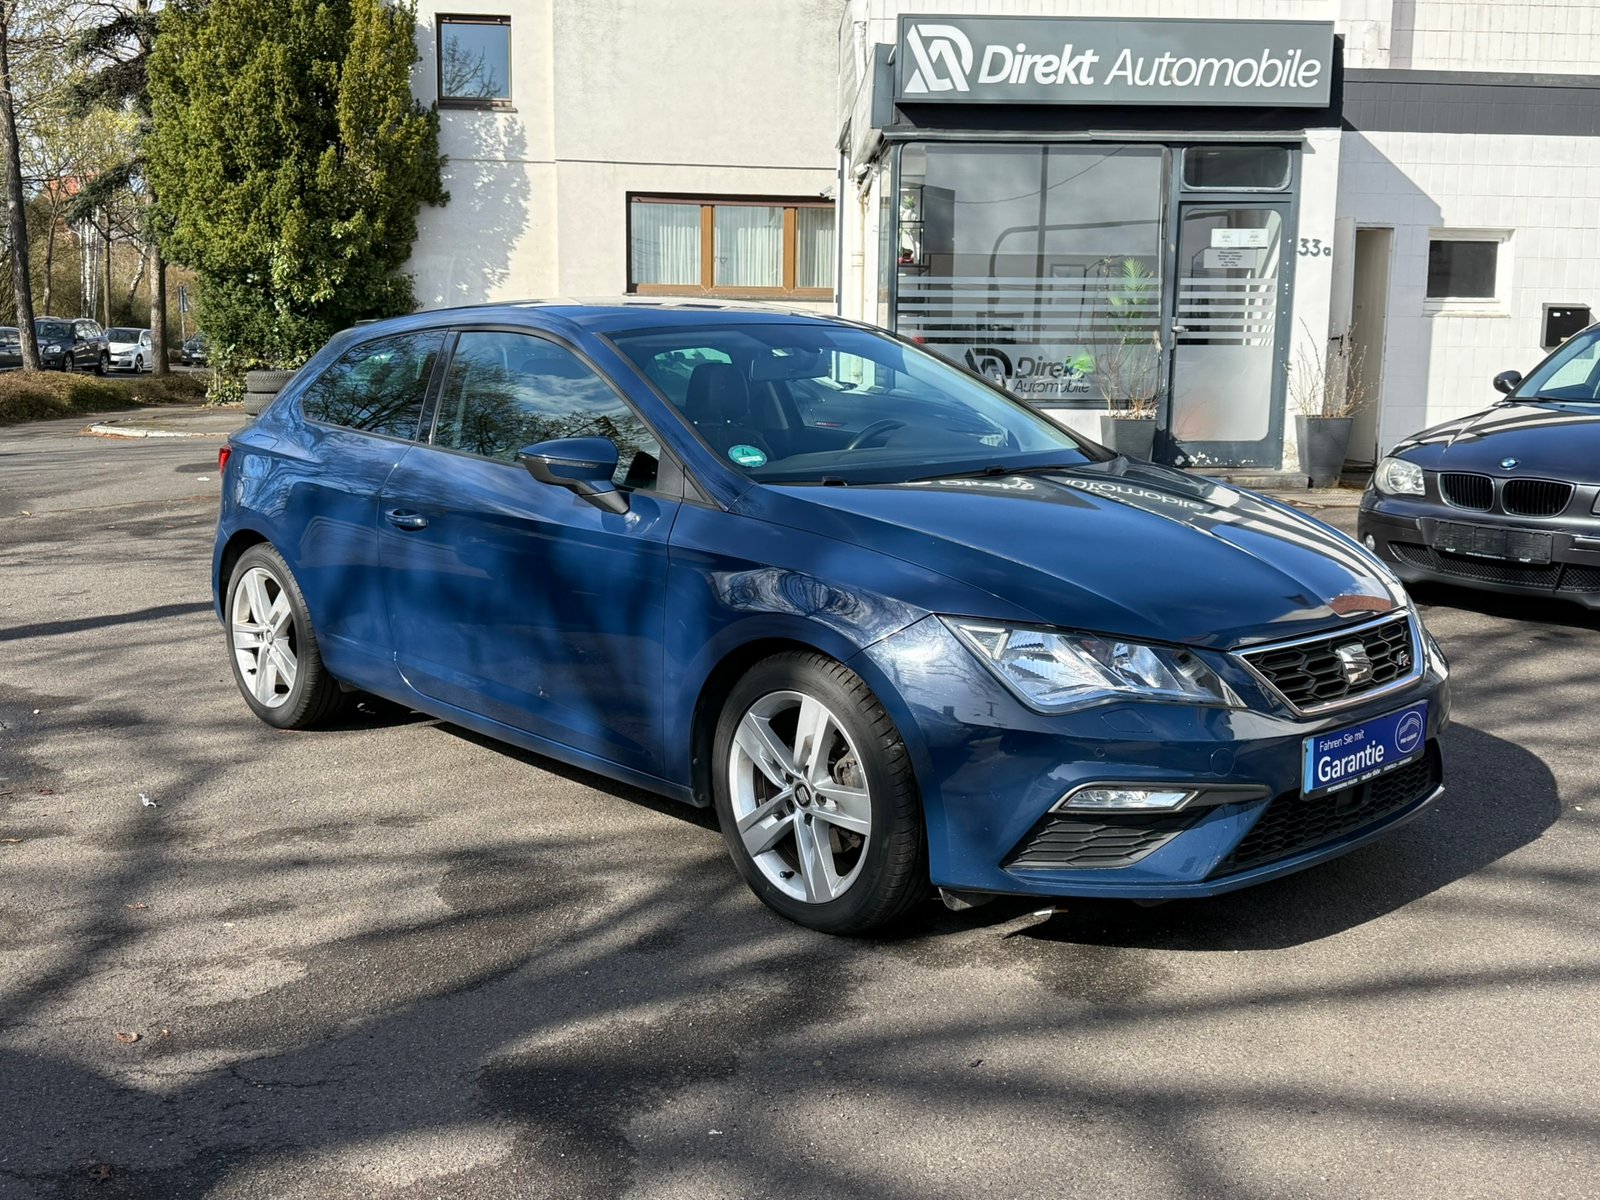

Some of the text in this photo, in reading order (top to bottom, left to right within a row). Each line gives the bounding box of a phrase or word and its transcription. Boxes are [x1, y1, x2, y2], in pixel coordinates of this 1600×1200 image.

[978, 43, 1099, 86] Direkt
[1104, 48, 1322, 88] Automobile
[1297, 238, 1331, 256] 33a
[1015, 356, 1085, 379] Direk
[1319, 729, 1365, 752] Fahren Sie mit
[1318, 740, 1384, 782] Garantie
